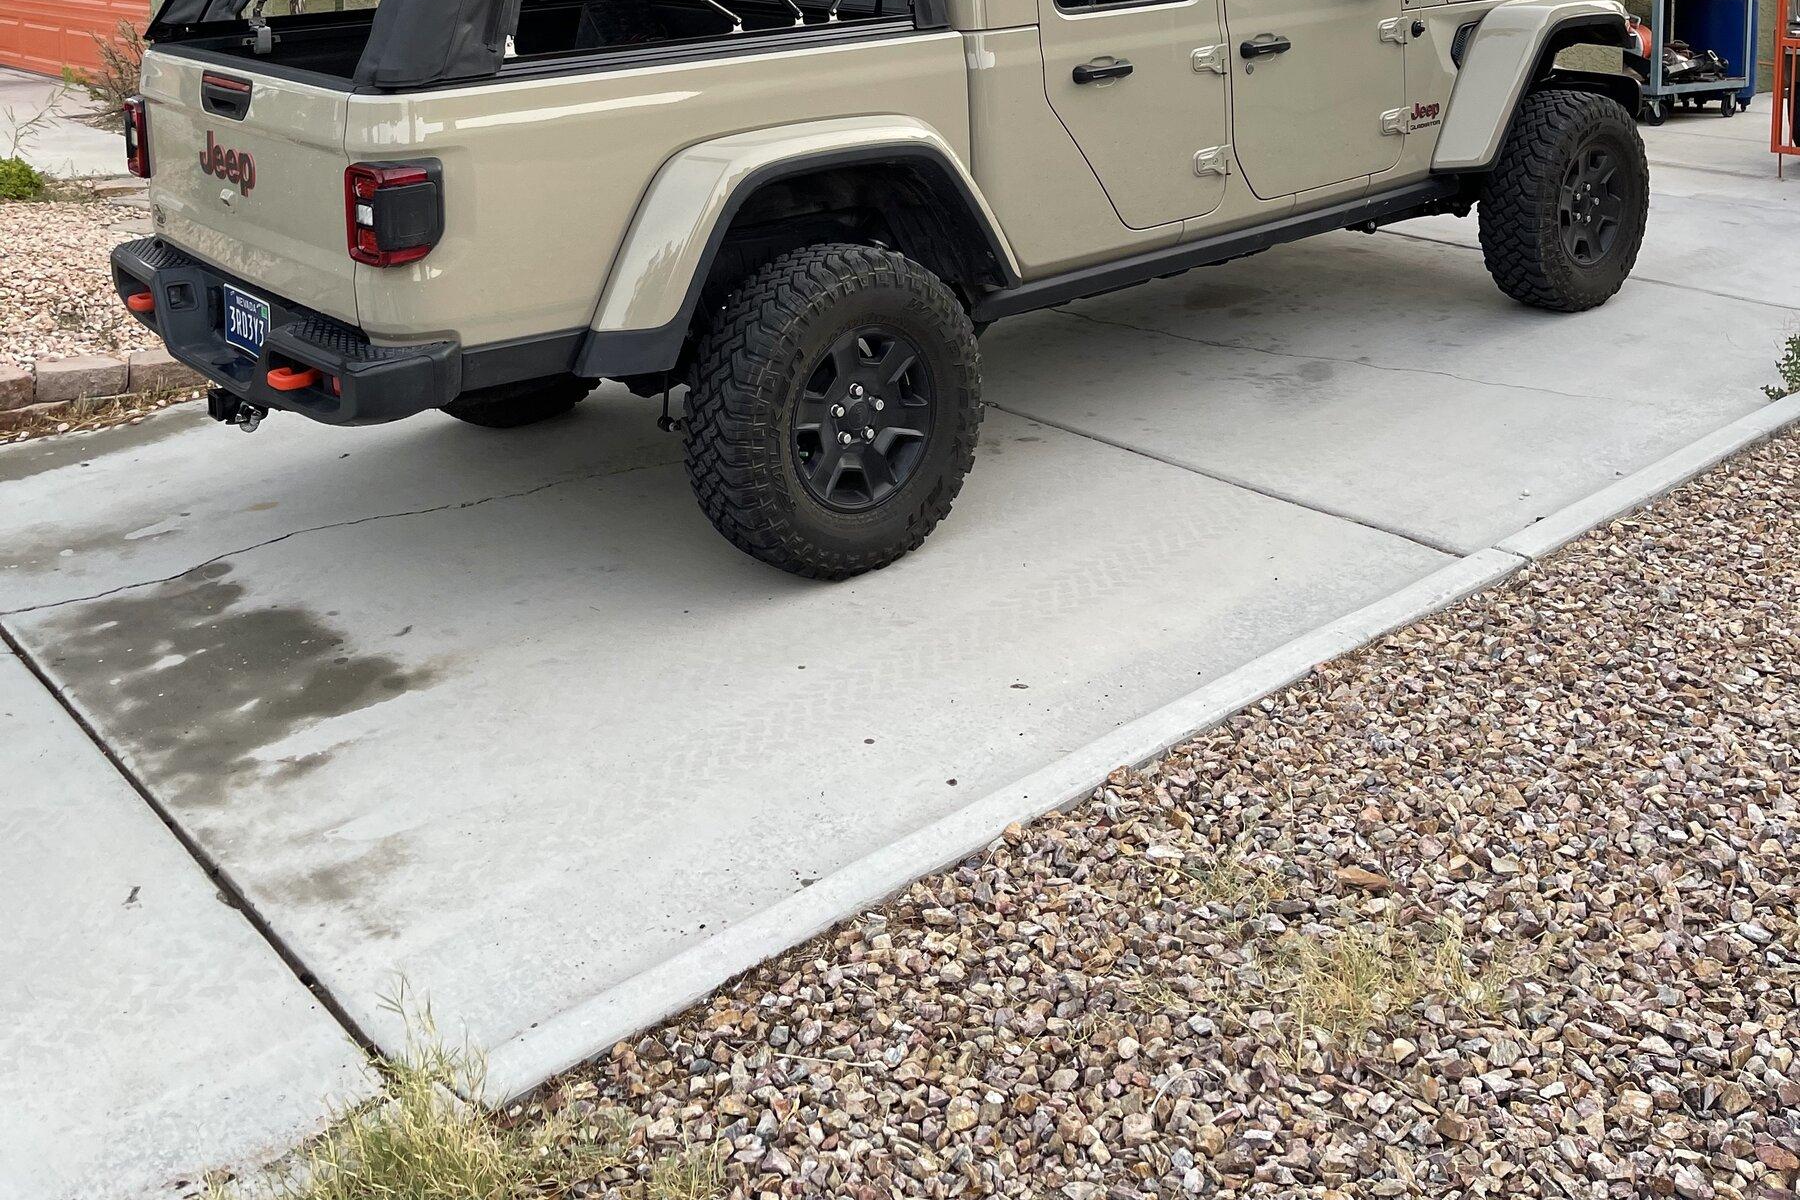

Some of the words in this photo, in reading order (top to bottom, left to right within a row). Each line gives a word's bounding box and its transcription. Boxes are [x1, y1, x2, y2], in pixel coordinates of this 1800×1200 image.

[1411, 102, 1440, 120] Jeep
[199, 130, 256, 197] Jeep
[229, 305, 264, 347] 3RD3Y3
